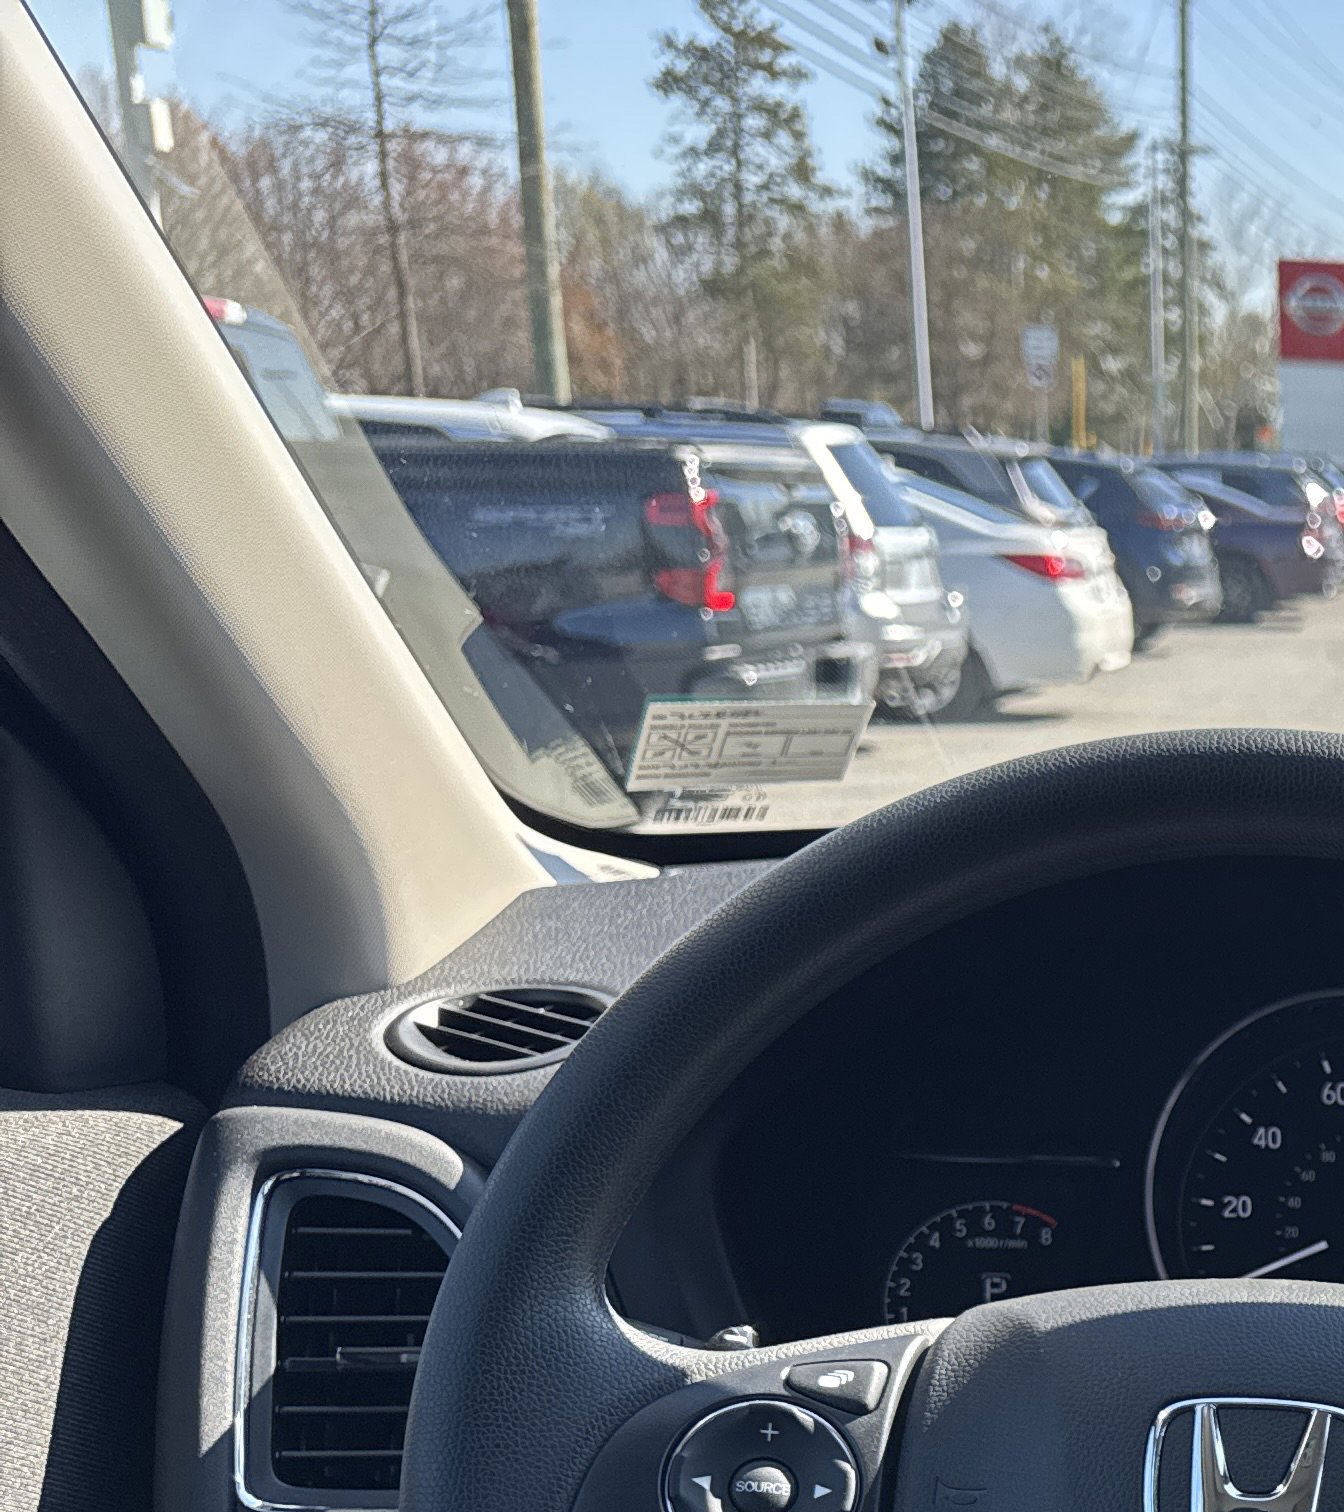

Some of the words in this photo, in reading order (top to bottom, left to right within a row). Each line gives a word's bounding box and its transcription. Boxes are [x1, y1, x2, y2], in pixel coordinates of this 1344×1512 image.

[1253, 1126, 1282, 1150] 40
[1222, 1195, 1253, 1219] 20
[956, 1220, 967, 1237] 5
[985, 1214, 996, 1230] 6
[1014, 1217, 1025, 1234] 7
[929, 1232, 940, 1248] 4
[1042, 1228, 1053, 1245] 8
[912, 1253, 922, 1270] 3
[900, 1280, 911, 1295] 2
[735, 1479, 791, 1497] SOURCE
